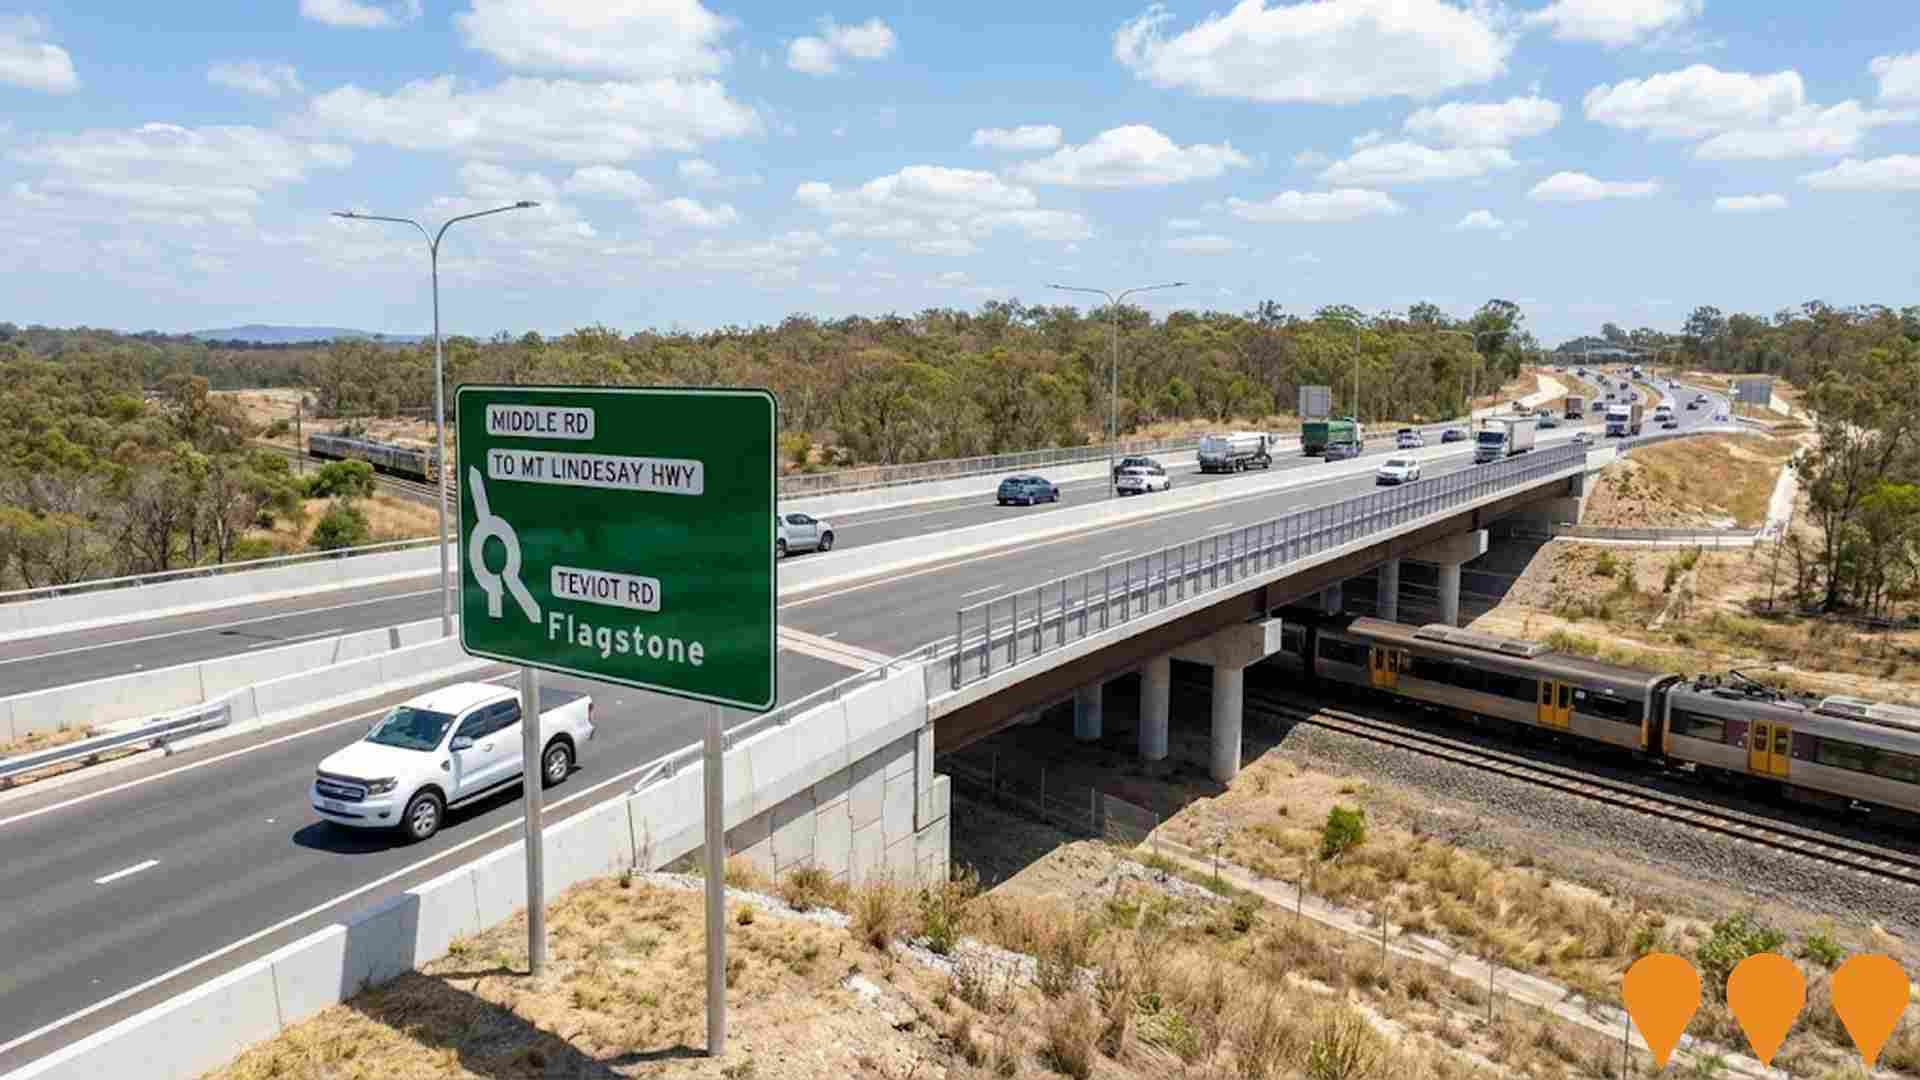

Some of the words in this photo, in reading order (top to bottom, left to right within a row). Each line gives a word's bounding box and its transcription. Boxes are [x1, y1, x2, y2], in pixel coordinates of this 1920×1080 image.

[492, 410, 557, 433] MIDDLE
[563, 412, 589, 434] RD
[493, 454, 515, 475] TO
[521, 456, 545, 478] MT
[552, 458, 645, 486] LINDESAY
[651, 464, 696, 488] HWY
[557, 571, 621, 601] TEVIOT
[628, 583, 655, 604] RD
[548, 612, 705, 666] Flagstone
